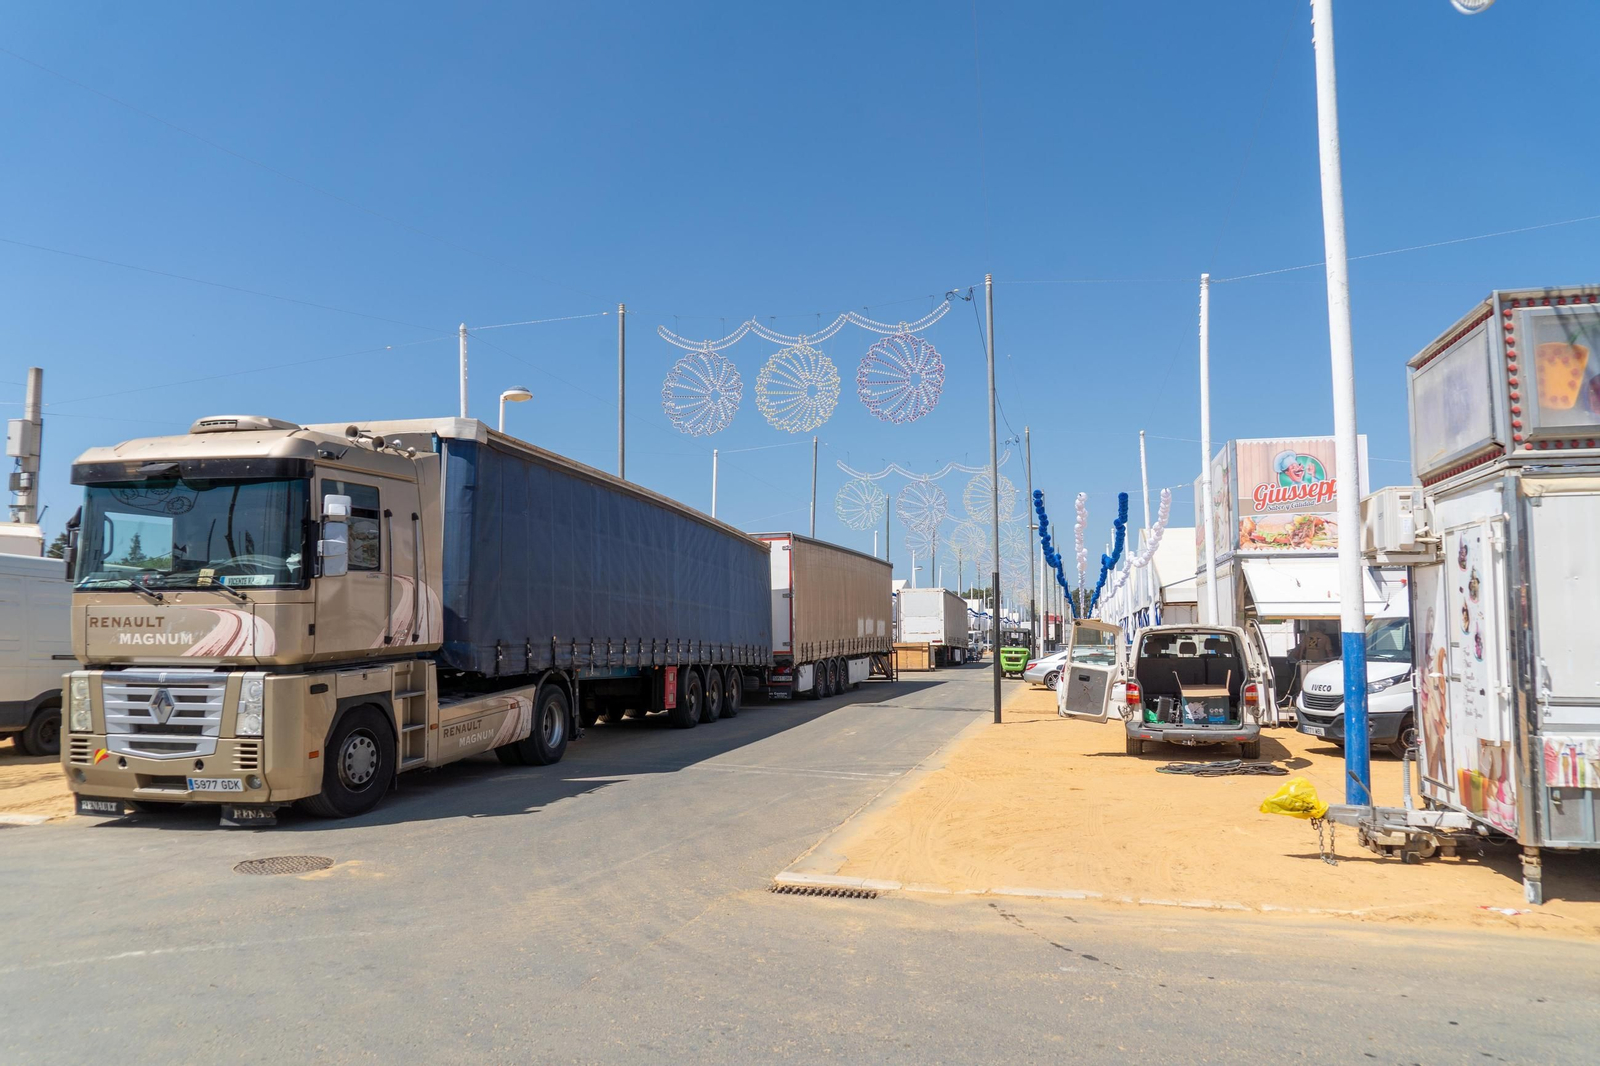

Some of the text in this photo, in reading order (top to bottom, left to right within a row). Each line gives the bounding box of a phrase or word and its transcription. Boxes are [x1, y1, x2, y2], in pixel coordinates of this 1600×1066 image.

[1252, 477, 1337, 511] Giussepp
[89, 616, 165, 628] RENAULT
[119, 632, 193, 645] MAGNUM
[1311, 684, 1332, 692] IVECO
[443, 719, 482, 738] RENAULT
[459, 729, 495, 748] MAGNUM
[194, 779, 217, 790] 5977
[81, 800, 118, 811] RENAULT
